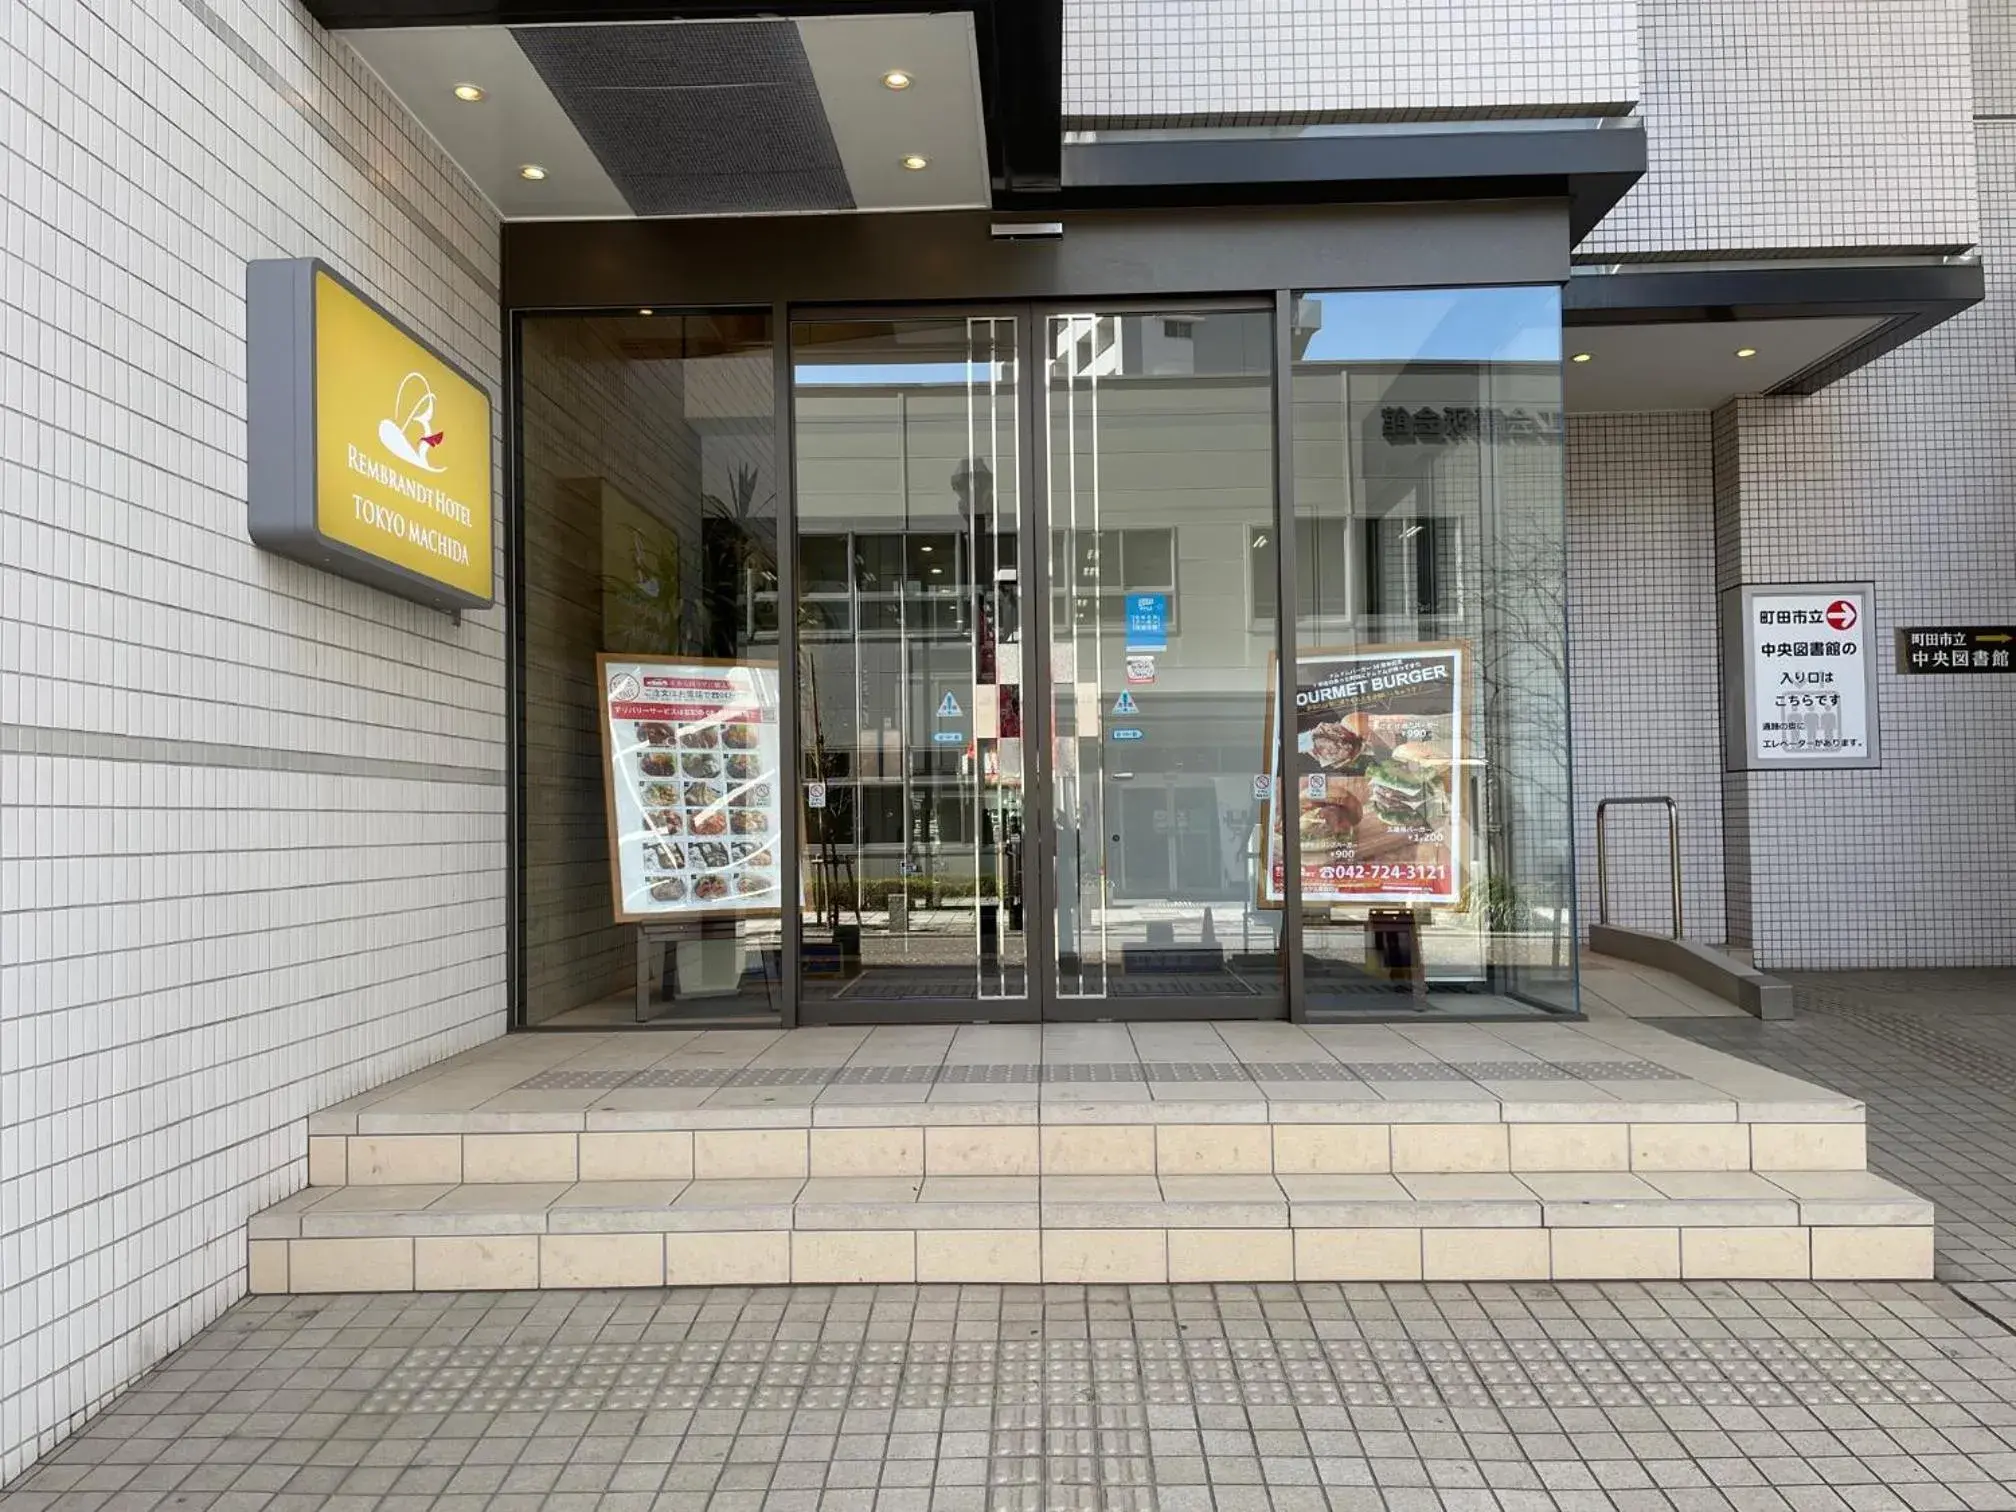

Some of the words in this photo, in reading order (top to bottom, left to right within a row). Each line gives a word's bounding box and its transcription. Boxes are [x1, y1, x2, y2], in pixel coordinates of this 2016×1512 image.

[352, 494, 405, 537] TOKYO
[409, 523, 469, 566] MACHIDA
[1760, 610, 1824, 625] 町田市立
[1911, 631, 1967, 647] 町田市立
[1761, 641, 1857, 657] 中央図書館の
[1912, 649, 2010, 668] 中央図書館
[1296, 679, 1370, 707] OURMET
[1371, 665, 1448, 692] BURGER
[1779, 671, 1834, 685] 入り口は
[1775, 693, 1841, 707] こちらです
[1335, 864, 1446, 880] 042-724-3121
